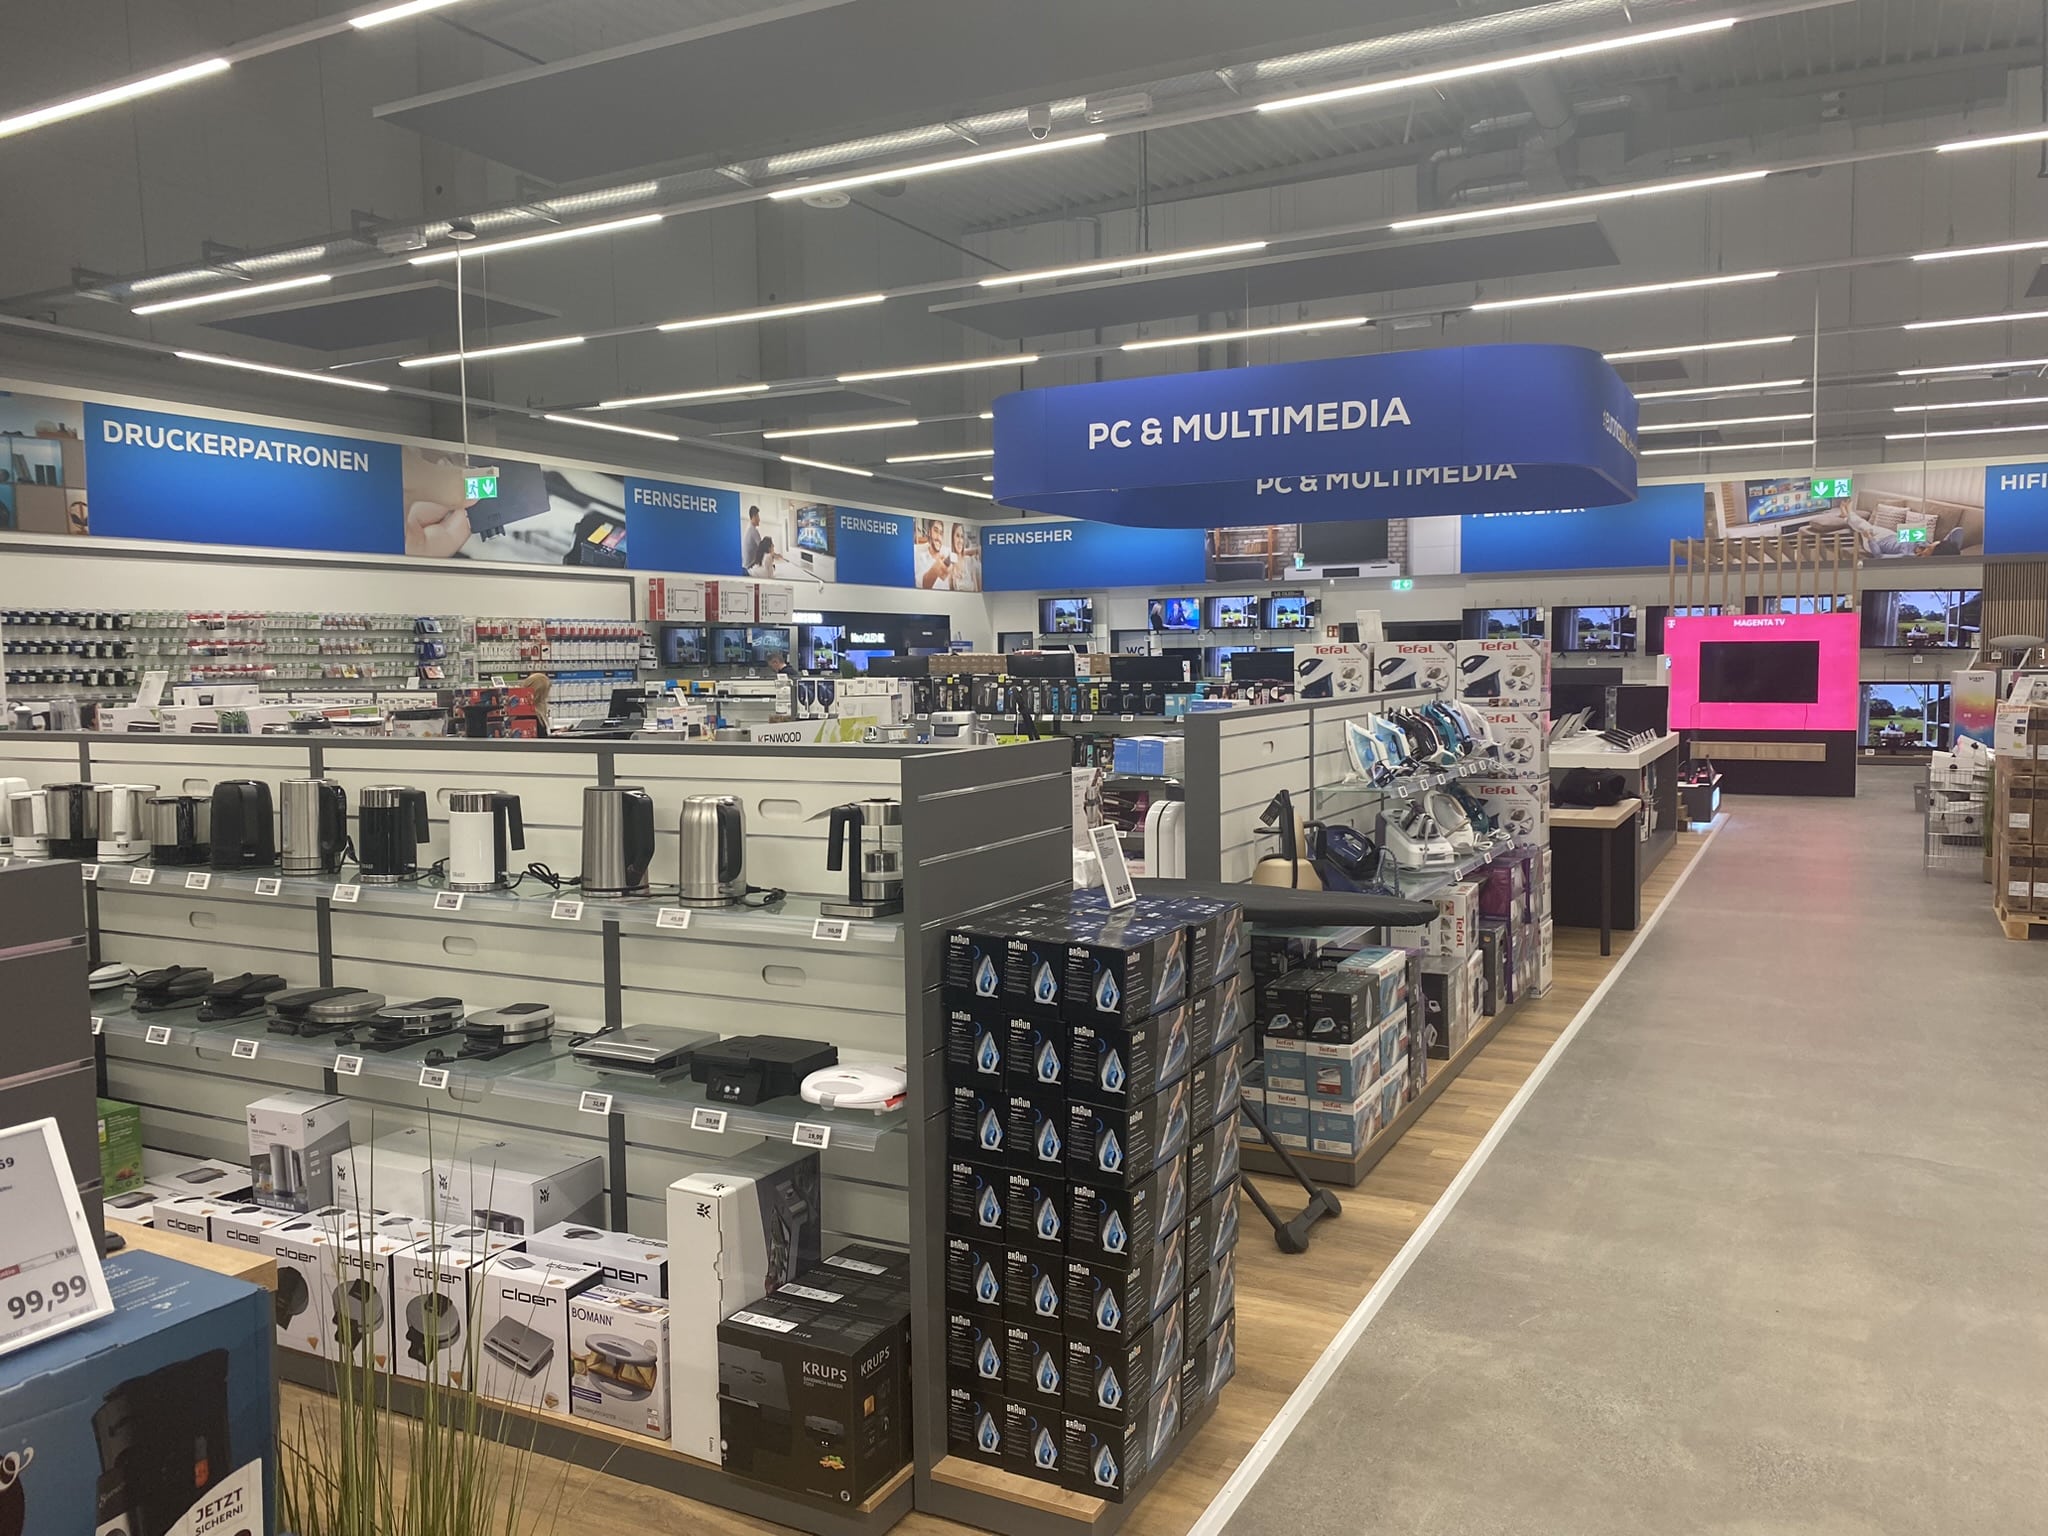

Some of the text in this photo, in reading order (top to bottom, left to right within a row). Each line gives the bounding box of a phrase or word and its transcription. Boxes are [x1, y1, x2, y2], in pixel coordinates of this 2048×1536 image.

[1088, 396, 1412, 450] PC & MULTIMEDIA
[103, 420, 369, 472] DRUCKERPATRONEN
[2001, 473, 2048, 490] HIFI
[634, 487, 718, 515] FERNSEHER
[840, 515, 898, 536] FERNSEHER
[988, 529, 1073, 546] FERNSEHER
[1733, 618, 1786, 629] MAGENTA TV
[1126, 647, 1144, 656] WC
[1314, 645, 1349, 655] Tefal
[1396, 644, 1435, 653] Tefal
[1480, 641, 1518, 651] Tefal
[1487, 714, 1518, 723] efal
[758, 732, 801, 743] KENWOOD
[1479, 785, 1518, 795] Tefal
[1456, 916, 1465, 948] Tefal
[951, 933, 970, 945] BRAUN
[1008, 940, 1027, 951] BRAUN
[1069, 947, 1089, 958] BRAUN
[952, 1011, 971, 1021] BRAUN
[1011, 1019, 1030, 1030] BRAUN
[1074, 1026, 1094, 1038] BRAUN
[955, 1087, 974, 1098] BRAUN
[1010, 1097, 1030, 1108] BRAUN
[1072, 1105, 1092, 1117] BRAUN
[953, 1163, 972, 1174] BRAUN
[1010, 1175, 1029, 1187] BRAUN
[1074, 1186, 1095, 1198] BRAUN
[167, 1218, 204, 1233] cloer
[227, 1229, 260, 1245] cloe
[950, 1240, 969, 1251] BRAUN
[275, 1247, 317, 1263] cloer
[1008, 1251, 1027, 1263] BRAUN
[339, 1254, 384, 1271] cloer
[546, 1262, 587, 1272] cloer
[413, 1265, 462, 1285] cloer
[1069, 1264, 1090, 1276] BRAUN
[8, 1275, 87, 1319] 99,99
[502, 1288, 557, 1307] cloer
[571, 1307, 612, 1326] BOMANN
[951, 1315, 970, 1326] BRAUN
[1008, 1328, 1028, 1340] BRAUN
[1069, 1342, 1090, 1354] BRAUN
[861, 1346, 890, 1376] KRUPS
[802, 1361, 847, 1382] KRUPS
[951, 1388, 970, 1400] BRAUN
[1007, 1404, 1026, 1416] BRAUN
[1065, 1420, 1086, 1432] BRAUN
[195, 1488, 243, 1523] JETZT
[195, 1504, 244, 1536] SICHERN!
